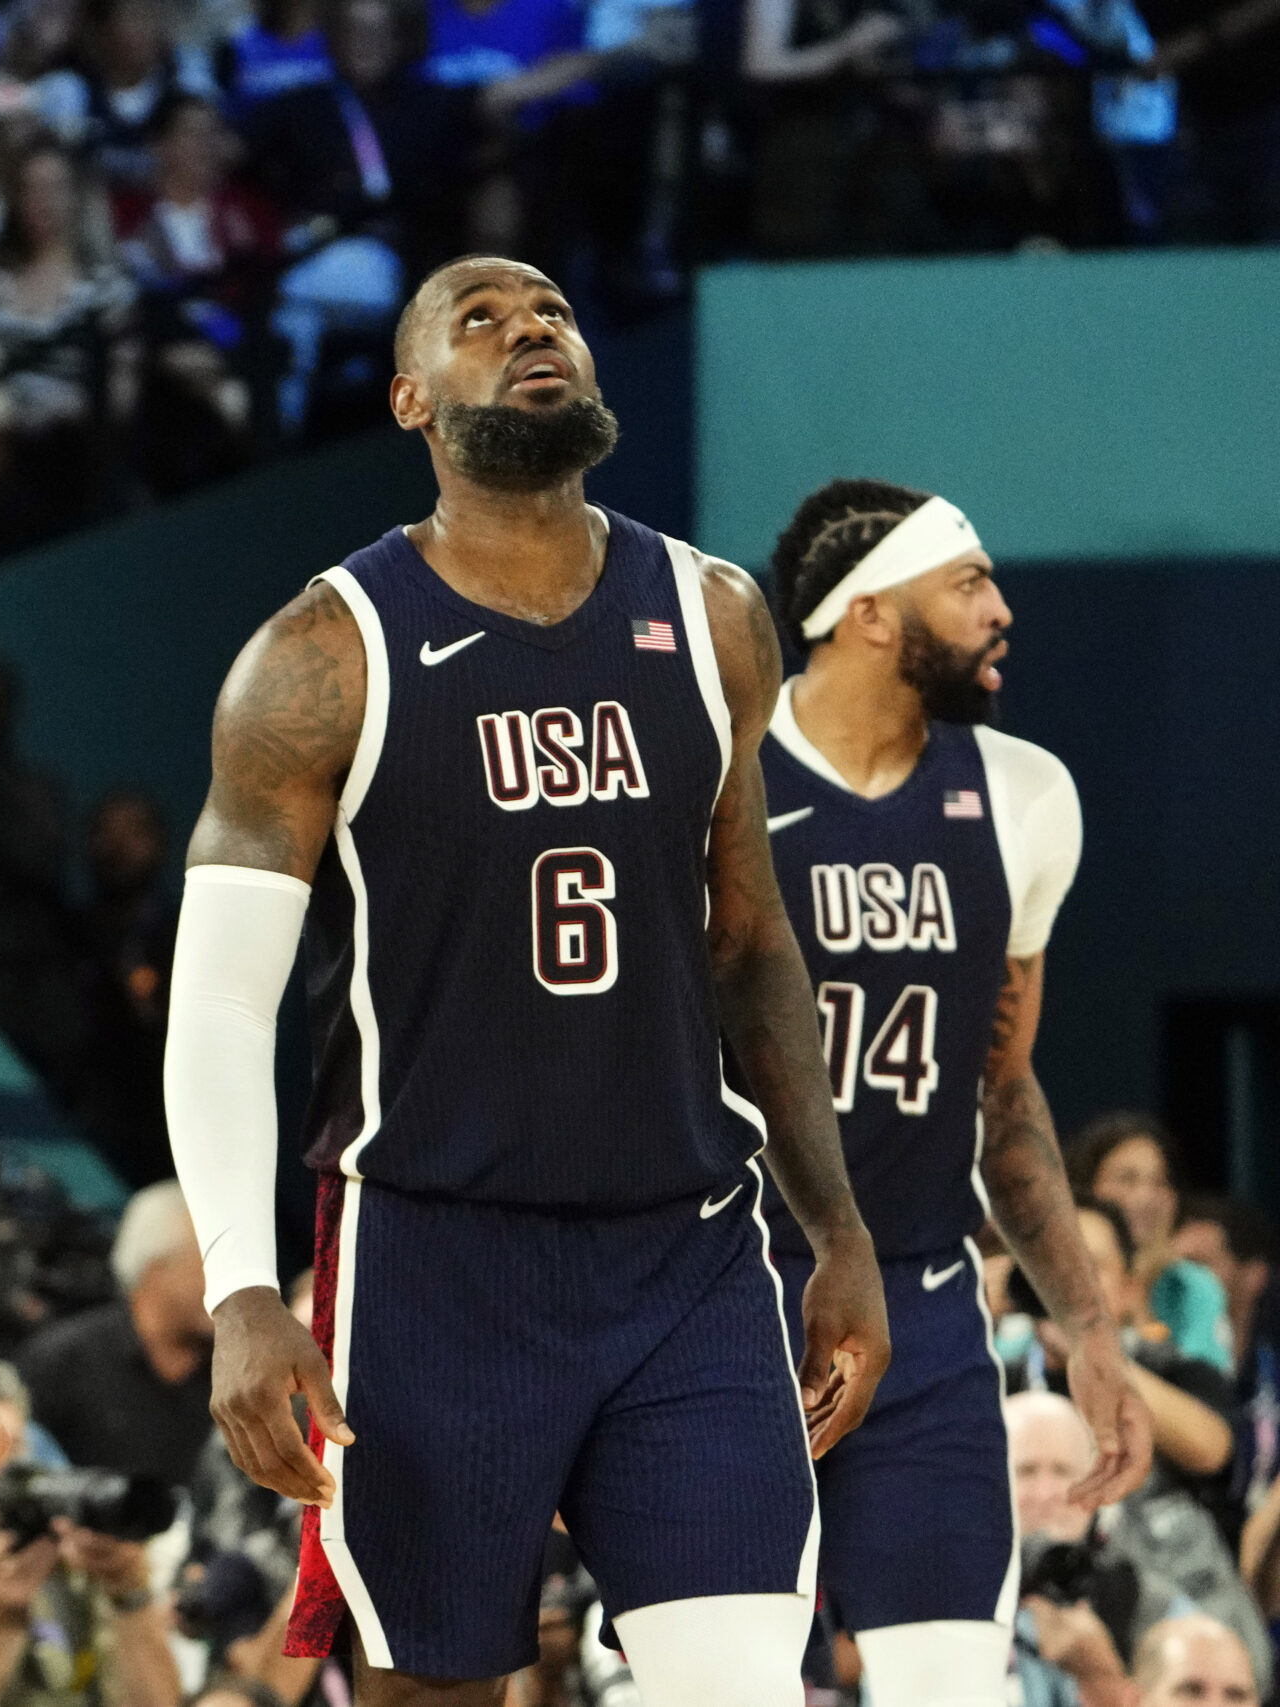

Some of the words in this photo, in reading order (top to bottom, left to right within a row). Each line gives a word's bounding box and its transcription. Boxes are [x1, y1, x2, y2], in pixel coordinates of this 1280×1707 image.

[477, 701, 649, 810] USA
[532, 847, 618, 995] 6
[810, 863, 957, 953] USA
[818, 981, 938, 1114] 14
